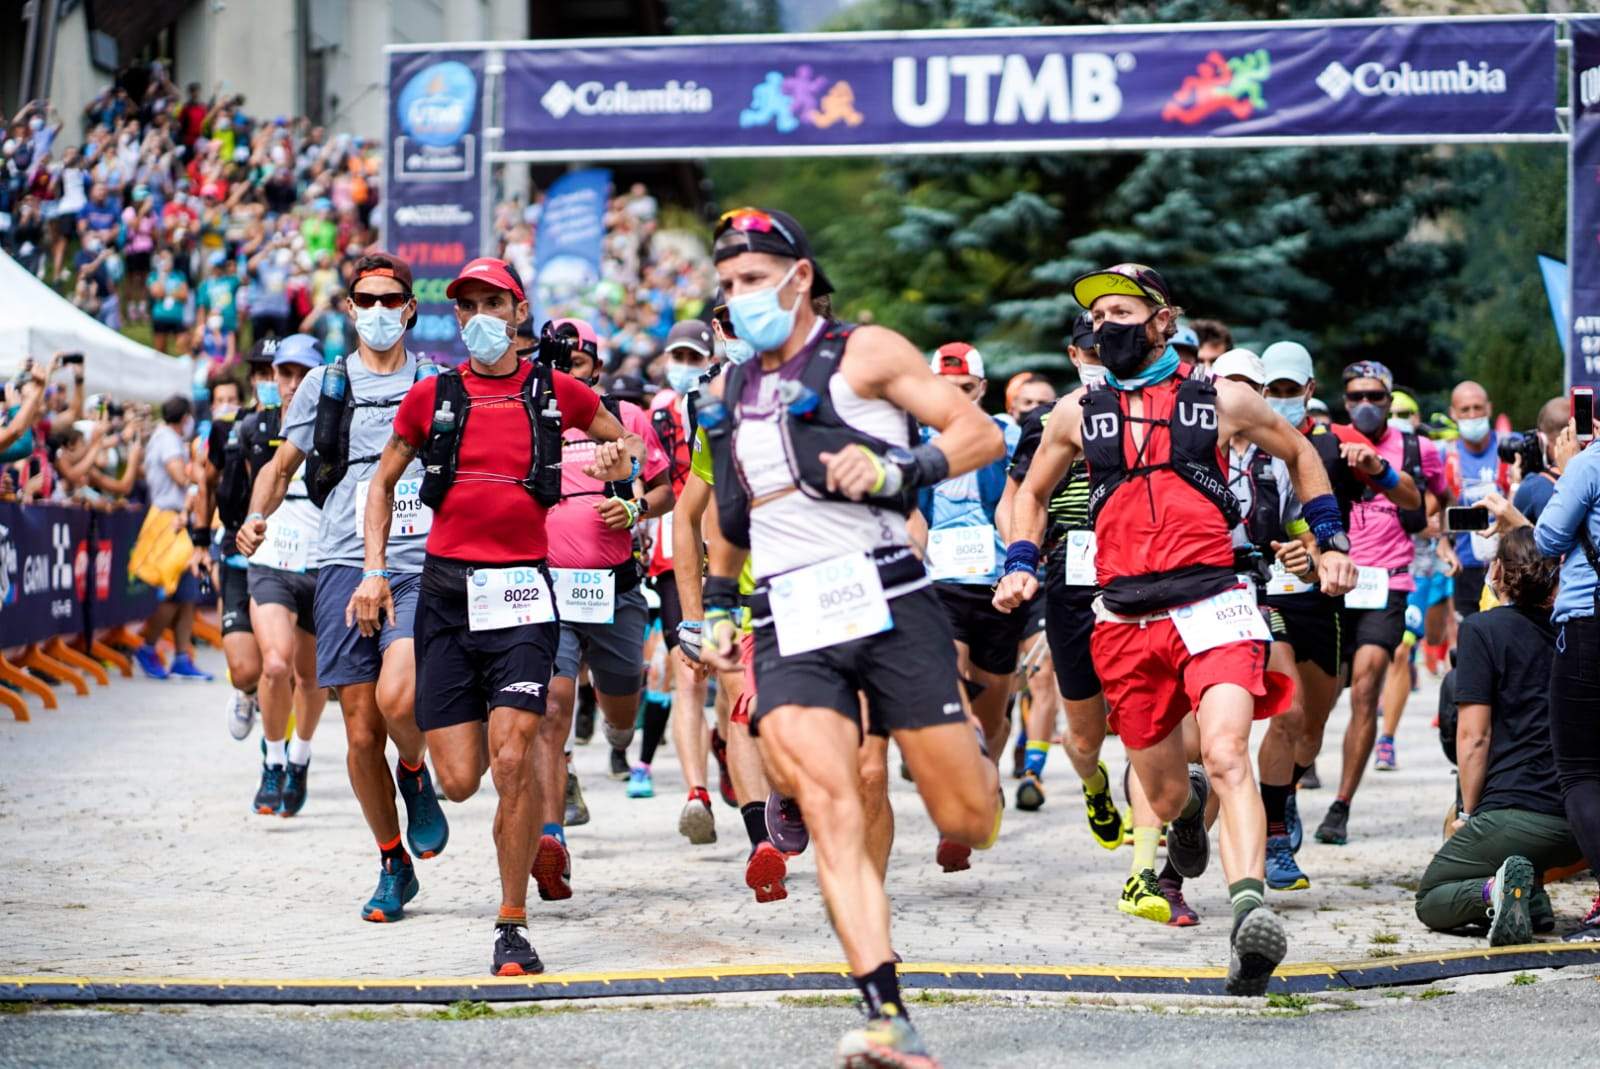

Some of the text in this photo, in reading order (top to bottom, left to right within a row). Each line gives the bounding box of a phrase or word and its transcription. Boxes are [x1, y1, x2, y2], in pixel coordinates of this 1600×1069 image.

[1353, 60, 1507, 97] Columbia
[572, 80, 713, 115] Columbia
[1082, 412, 1119, 441] UD
[505, 570, 535, 585] TDS
[573, 572, 602, 584] TDS
[504, 588, 540, 602] 8022
[571, 588, 604, 600] 8010
[820, 582, 866, 609] 8053
